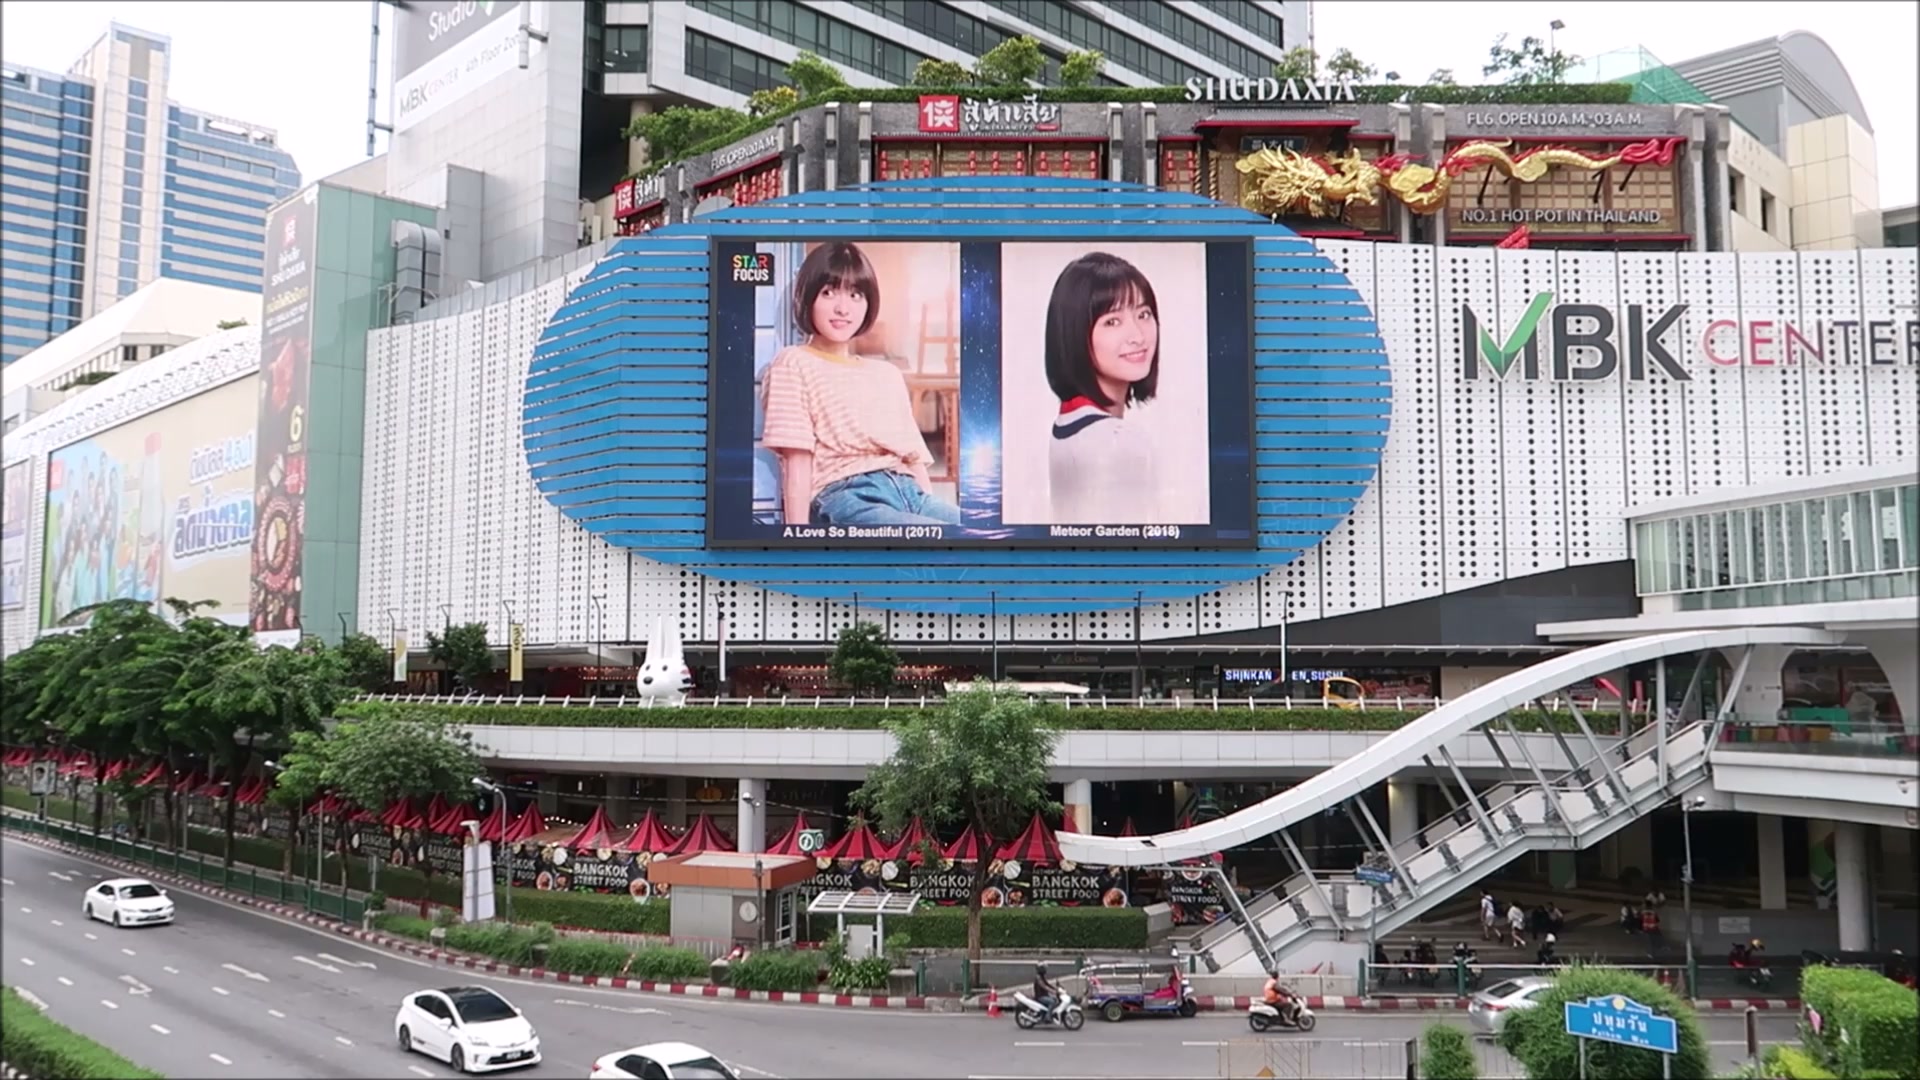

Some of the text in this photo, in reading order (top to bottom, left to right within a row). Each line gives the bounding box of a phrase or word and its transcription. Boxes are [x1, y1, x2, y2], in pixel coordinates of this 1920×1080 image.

[428, 0, 477, 41] Studio
[1184, 76, 1357, 101] SHUDAXIA
[400, 82, 428, 117] MBK
[1462, 209, 1661, 224] NO.1 HOT POT IN THAILAND
[732, 254, 769, 269] STAR
[732, 268, 770, 282] FOCUS
[1462, 291, 1694, 382] MBK
[783, 526, 943, 540] A Love So Beautiful (2017)
[1050, 525, 1180, 539] Meteor Garden (2018)
[574, 862, 629, 878] BANGKOK
[573, 875, 629, 888] STREET FOOD
[1032, 875, 1100, 889] BANGKOK
[949, 888, 970, 899] FOO
[1032, 888, 1100, 899] STREET FOOD
[1592, 1011, 1648, 1033] ปทุมวัน
